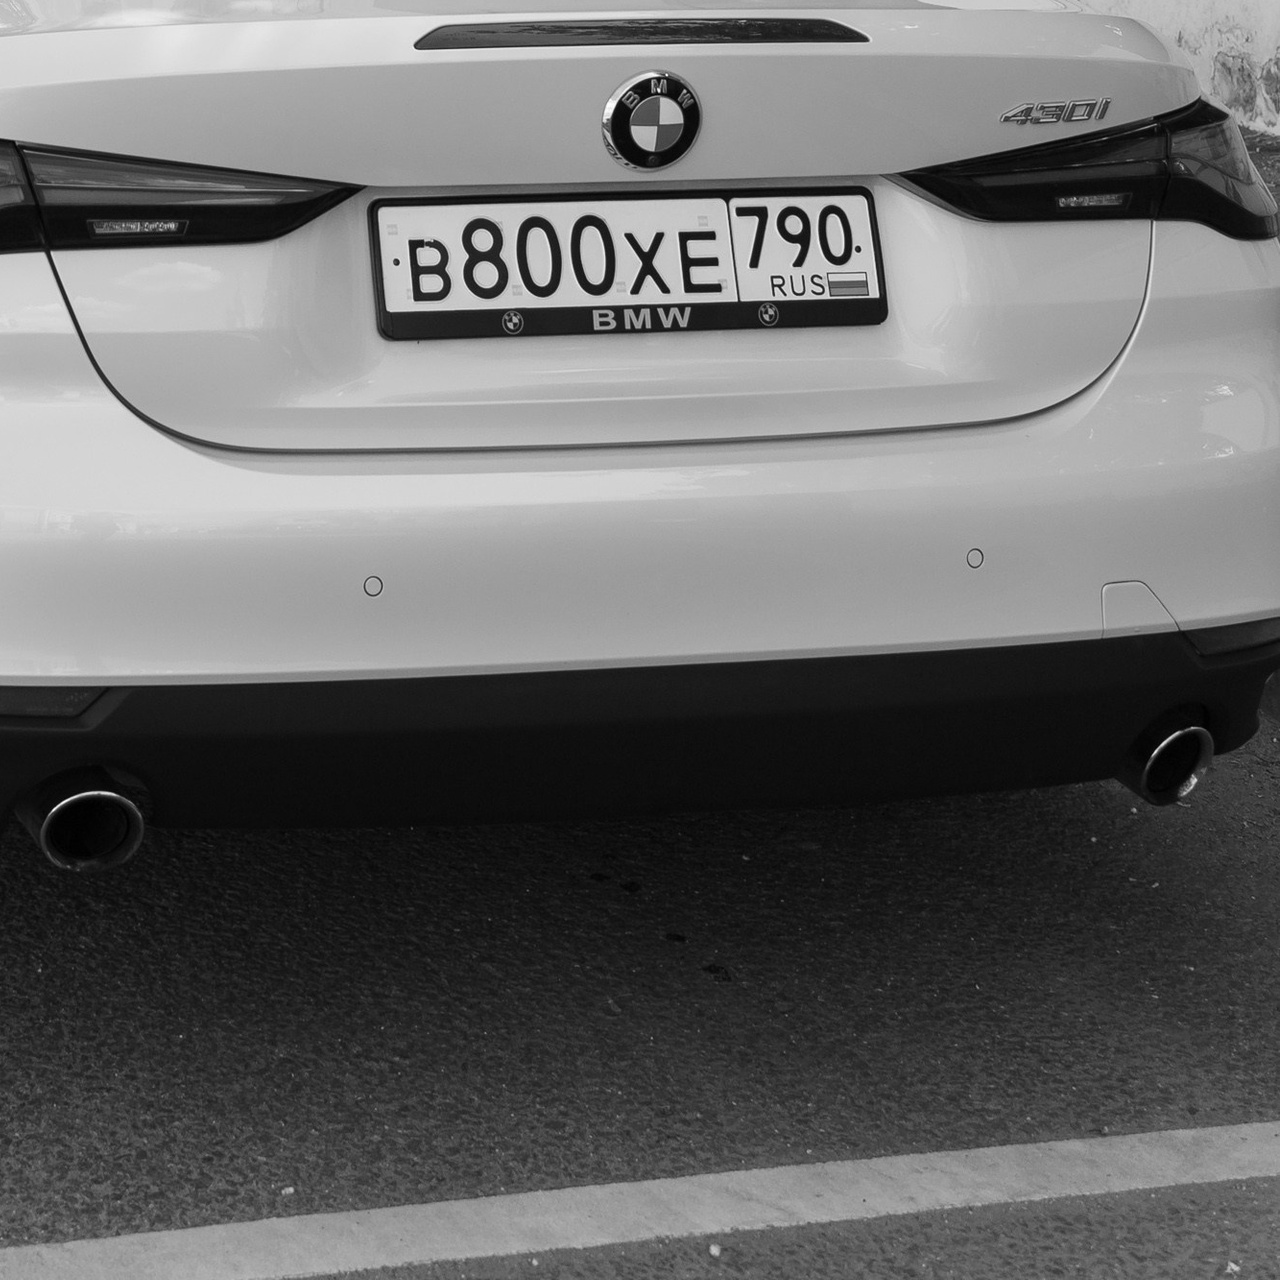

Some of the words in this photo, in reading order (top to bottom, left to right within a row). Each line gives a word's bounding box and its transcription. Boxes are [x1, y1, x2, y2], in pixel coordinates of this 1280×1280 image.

[621, 78, 695, 109] BMW
[735, 204, 853, 269] 790
[770, 274, 825, 297] RUS
[592, 306, 691, 331] BMW
